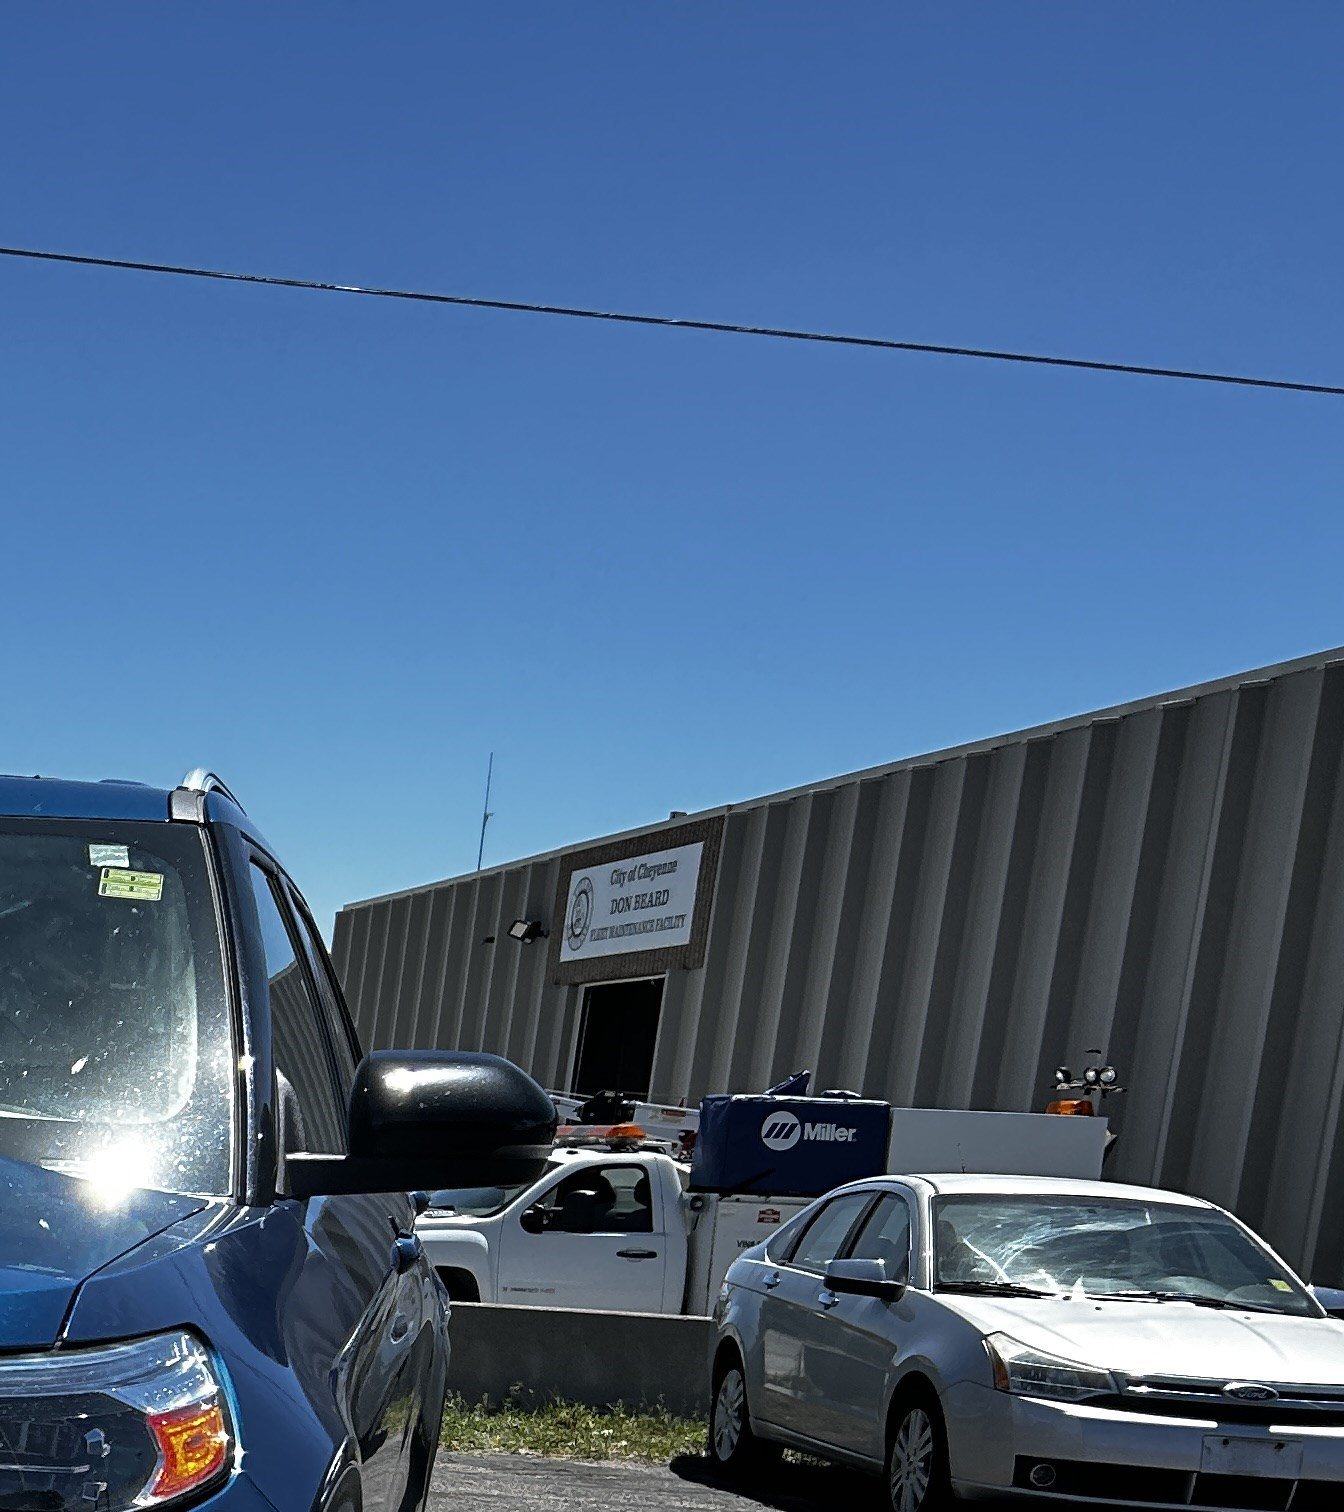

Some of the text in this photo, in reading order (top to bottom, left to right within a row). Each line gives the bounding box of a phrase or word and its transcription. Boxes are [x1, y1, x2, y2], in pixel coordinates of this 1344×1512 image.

[610, 860, 678, 888] City of Cheyenne
[610, 889, 670, 915] DON BEARD
[655, 913, 687, 932] FACILITY
[803, 1122, 857, 1142] Miller
